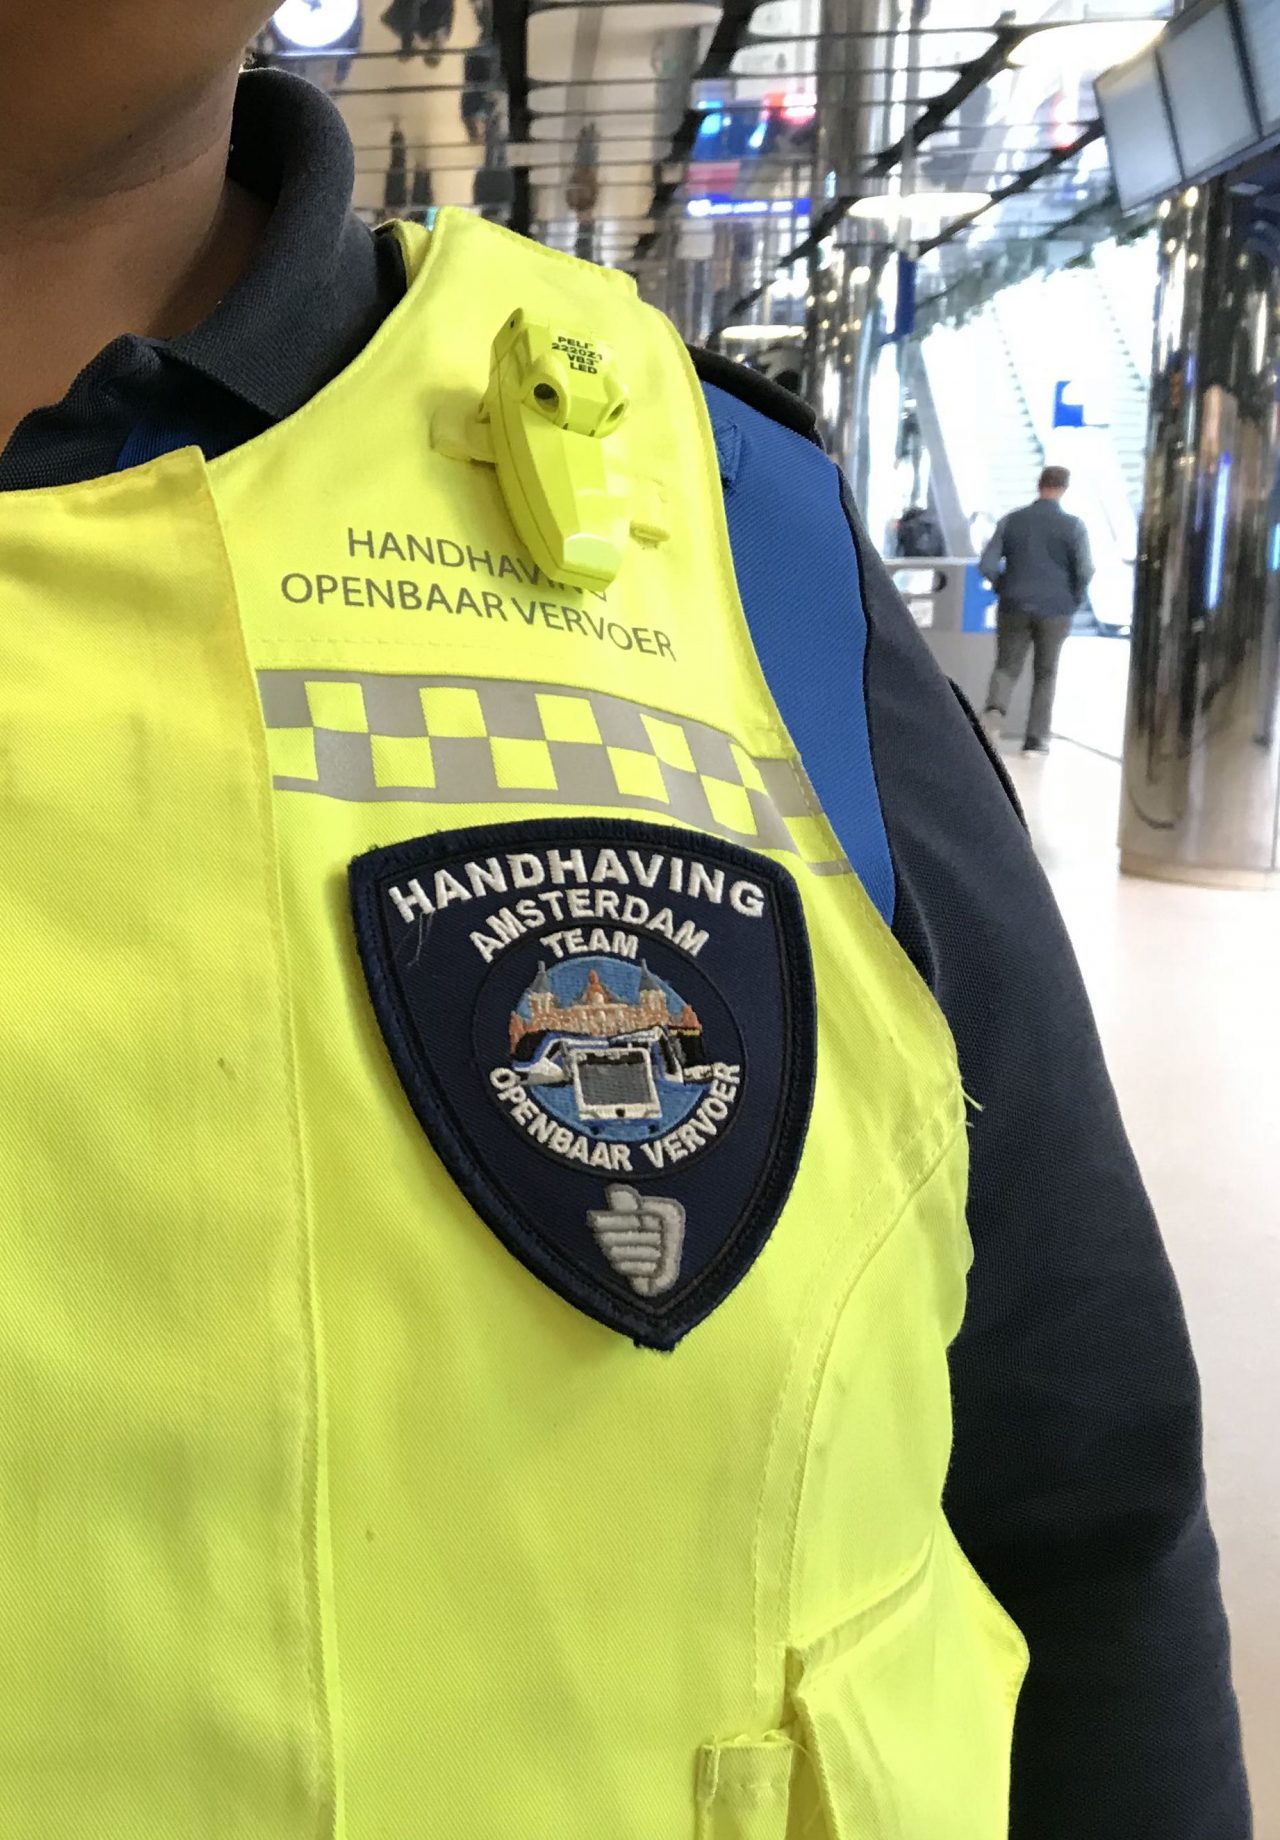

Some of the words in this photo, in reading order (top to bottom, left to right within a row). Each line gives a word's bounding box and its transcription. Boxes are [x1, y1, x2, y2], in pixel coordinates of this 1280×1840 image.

[570, 361, 598, 375] LED
[347, 526, 607, 603] HANDHAV
[280, 571, 509, 623] OPENBAAR
[510, 596, 677, 662] VERVOER
[387, 847, 766, 923] HANDHAVING
[468, 887, 710, 963] AMSTERDAM
[540, 927, 640, 960] TEAM
[489, 1066, 633, 1172] OPENBAAR
[639, 1061, 741, 1169] VERVOER
